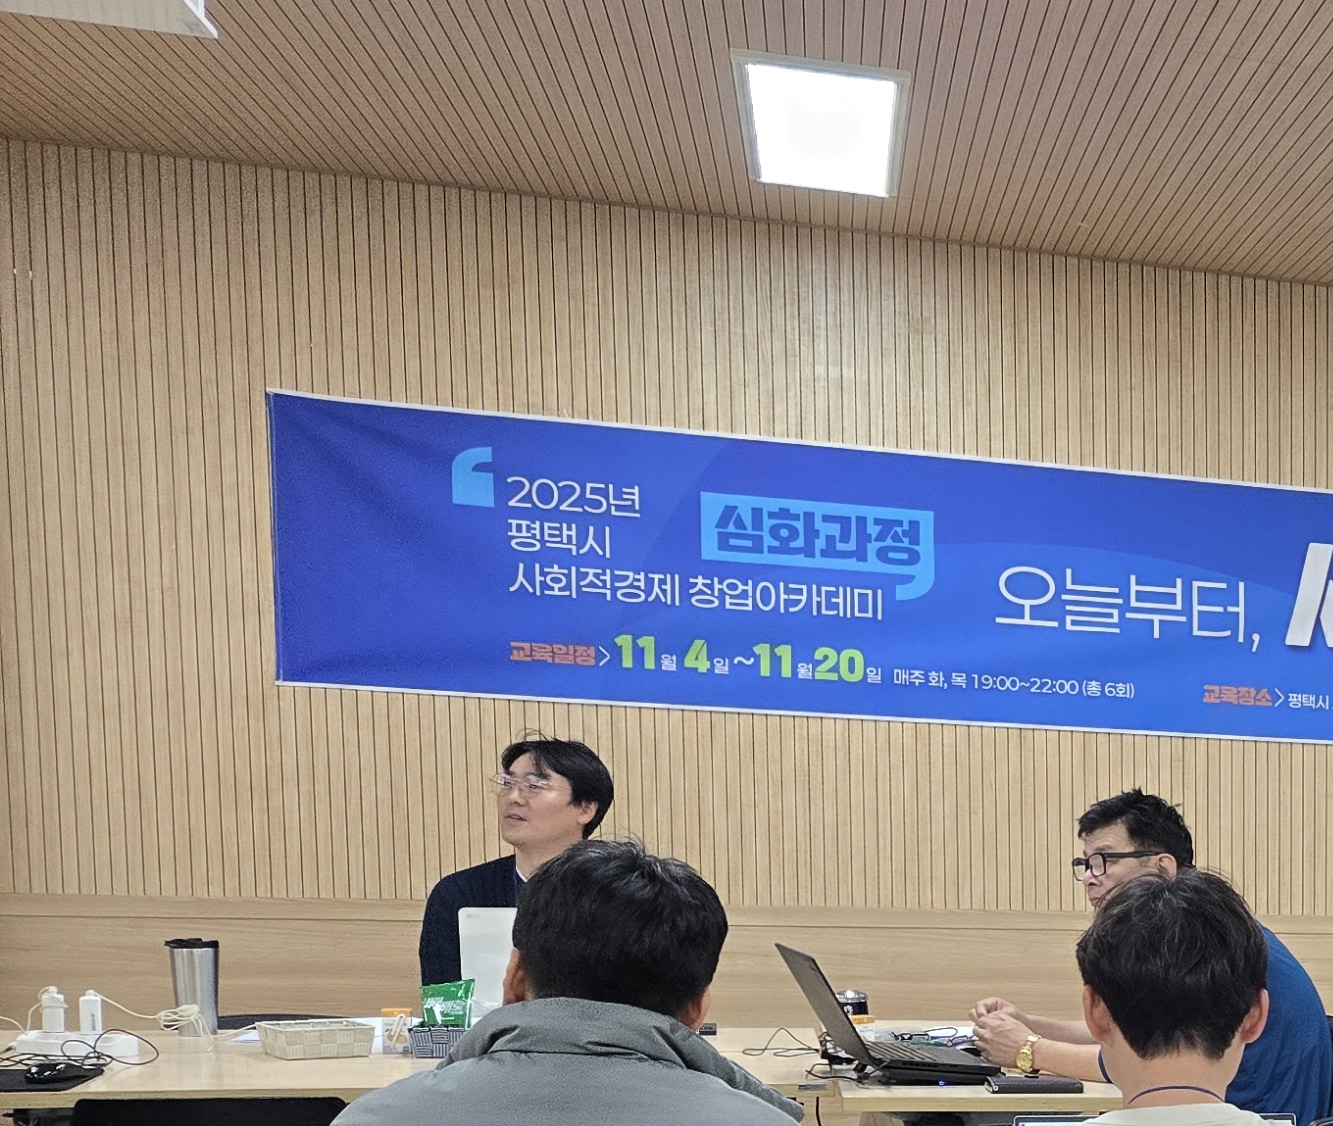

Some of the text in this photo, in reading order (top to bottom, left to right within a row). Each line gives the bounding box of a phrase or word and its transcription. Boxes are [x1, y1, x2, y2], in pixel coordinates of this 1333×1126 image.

[506, 475, 641, 518] 2025년
[507, 519, 611, 558] 평택시
[714, 505, 921, 567] 심화과정
[509, 562, 883, 620] 사회적경제 창업아카데미
[995, 565, 1260, 652] 오늘부터,
[510, 640, 596, 667] 교육일정
[893, 668, 925, 686] 매주
[950, 672, 967, 689] 목
[971, 674, 1079, 695] 19:00~22:00
[1203, 684, 1272, 707] 교육장소
[1288, 693, 1329, 711] 평택시
